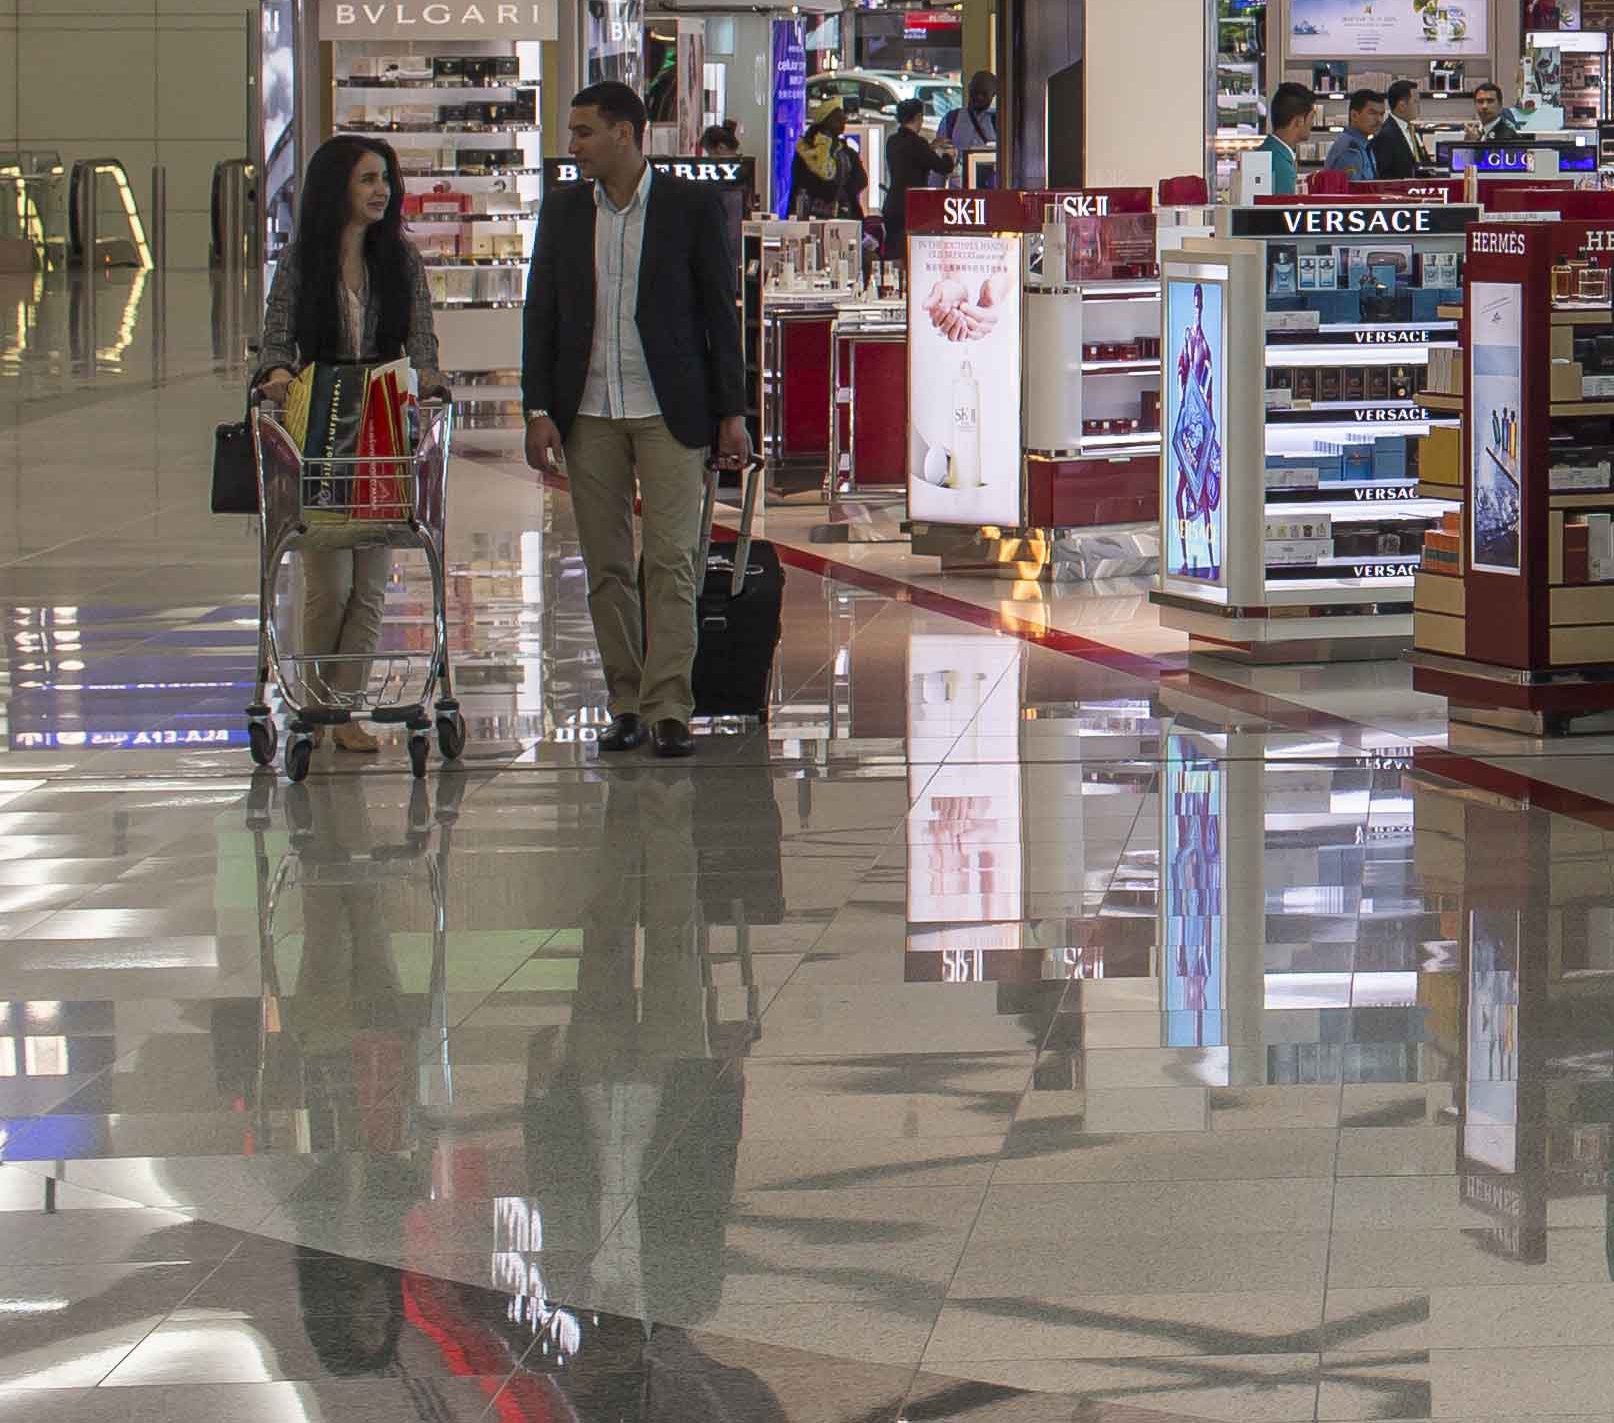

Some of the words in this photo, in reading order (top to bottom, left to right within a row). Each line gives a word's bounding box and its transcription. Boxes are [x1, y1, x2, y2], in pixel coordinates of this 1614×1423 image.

[336, 4, 540, 25] BVLGARI
[1488, 153, 1532, 166] GUC
[943, 197, 986, 226] SK-II
[1283, 210, 1432, 233] VERSACE
[1354, 330, 1430, 344] VERSACE
[1354, 409, 1430, 422] VERSACE
[1354, 488, 1418, 501] VERSAC
[1353, 565, 1418, 577] VERSAC
